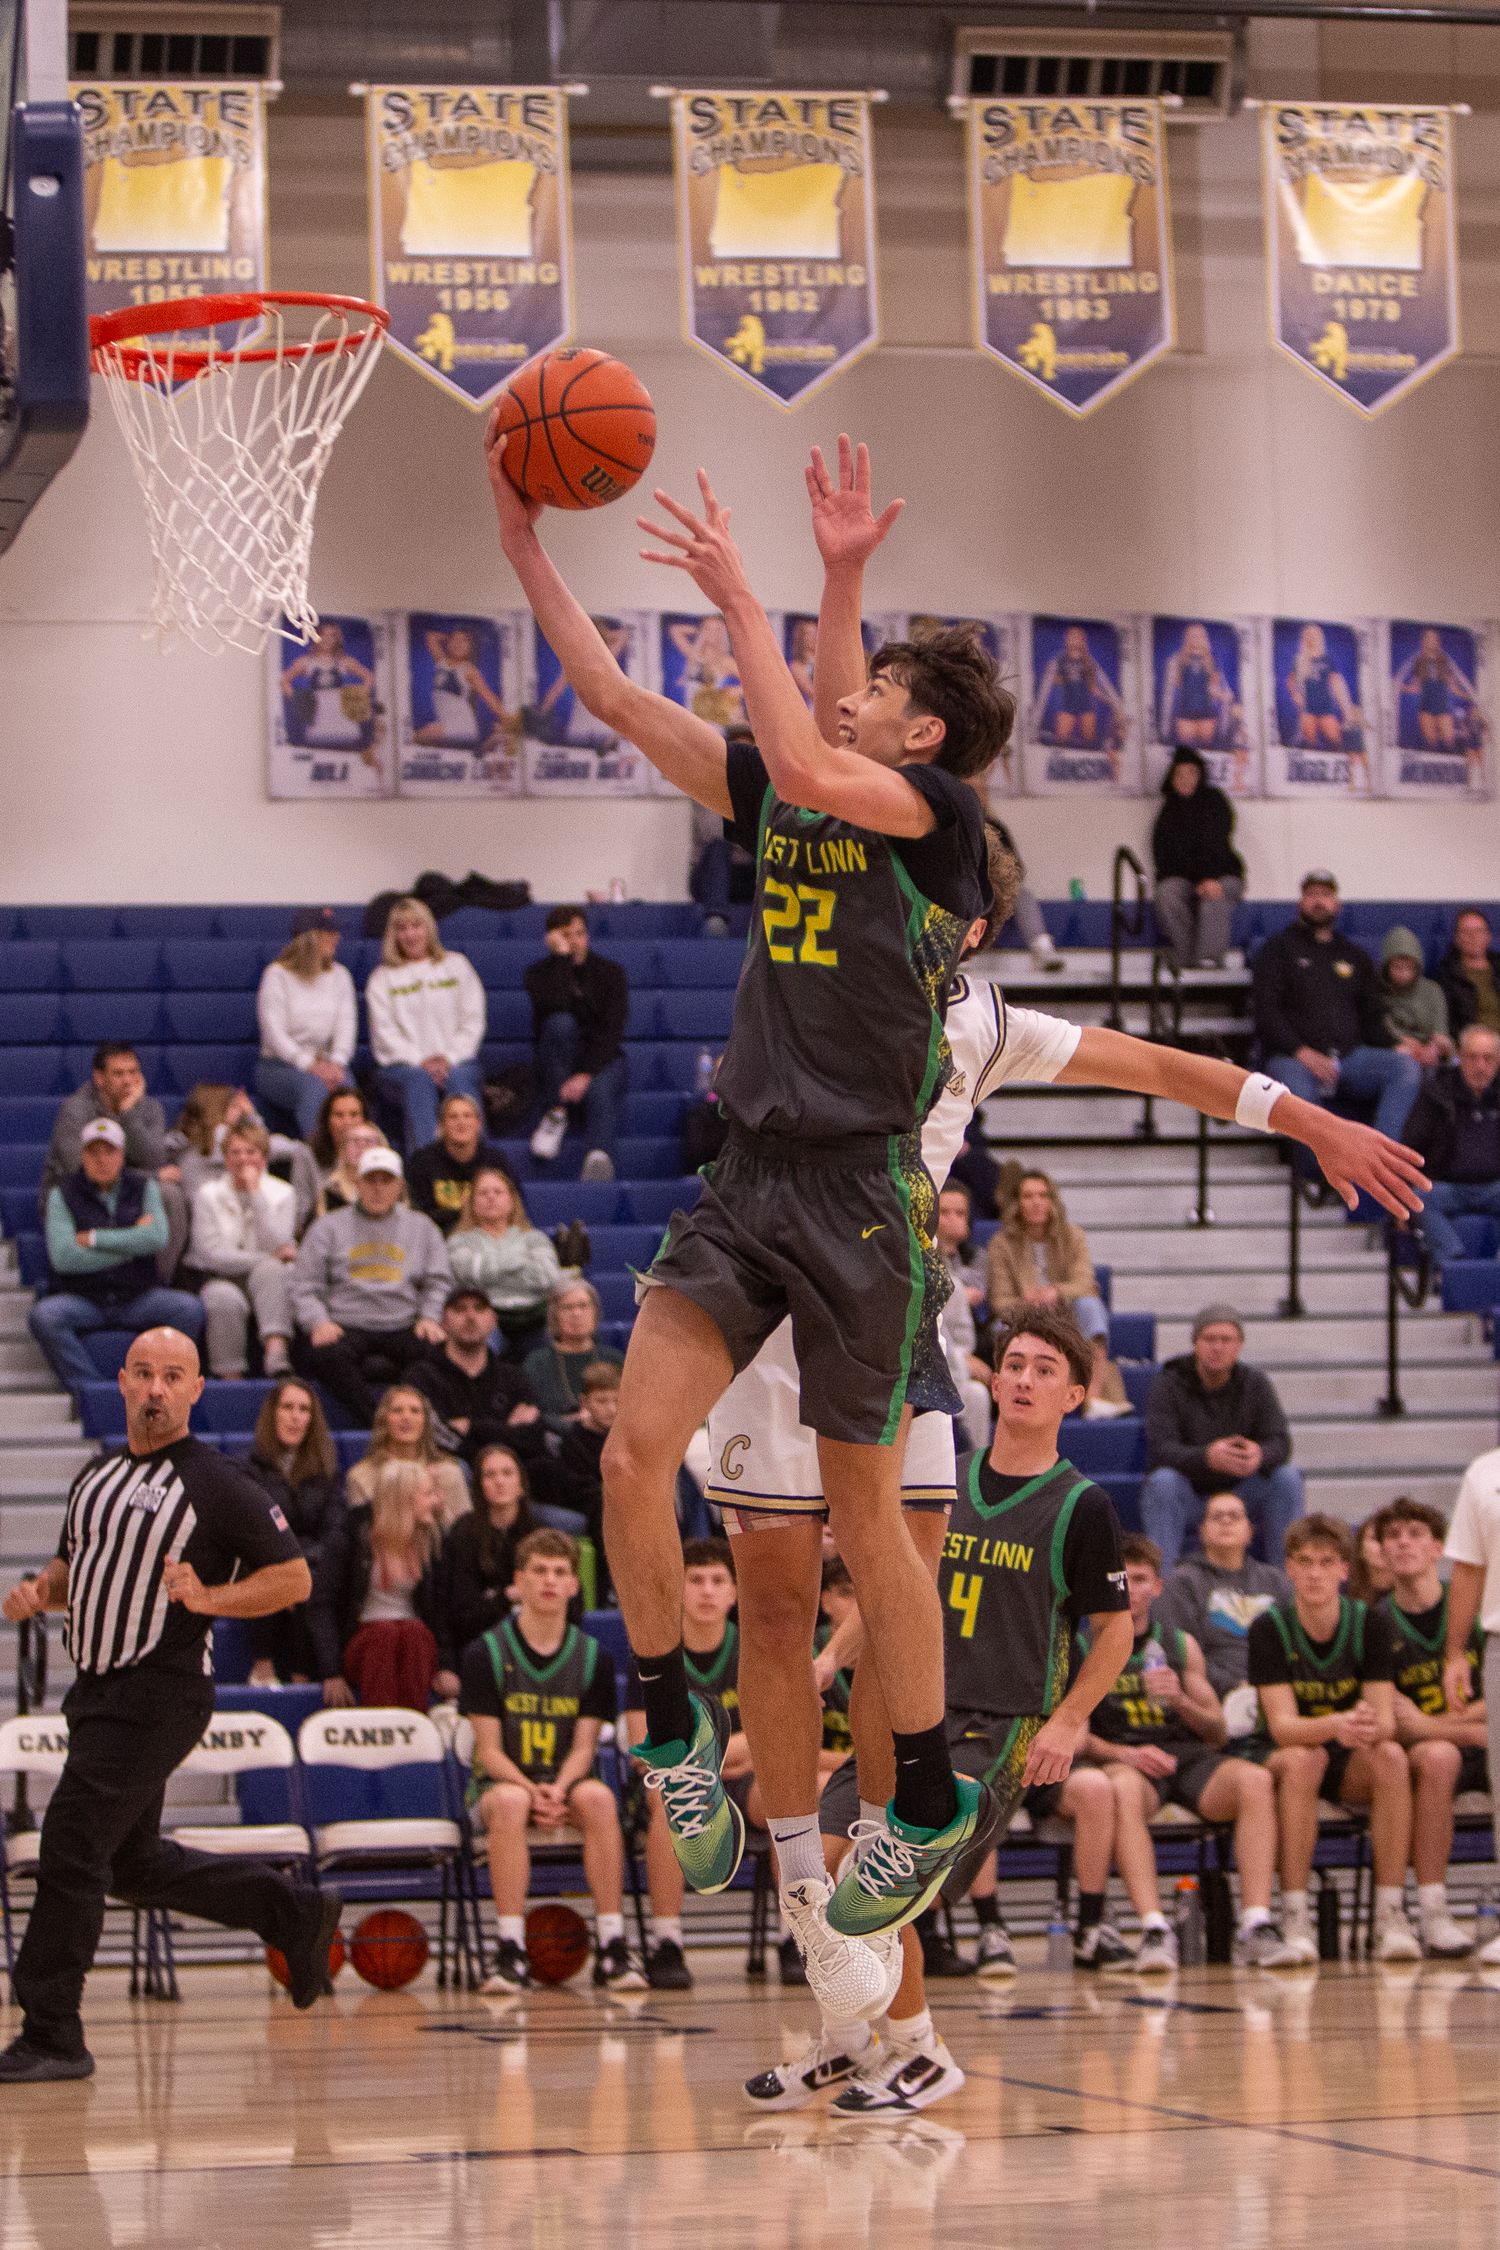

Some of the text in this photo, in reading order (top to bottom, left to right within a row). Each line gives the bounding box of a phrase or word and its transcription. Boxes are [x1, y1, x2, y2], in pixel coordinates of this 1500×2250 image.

[76, 89, 254, 131] STATE
[382, 91, 556, 134] STATE
[689, 96, 860, 138] STATE
[983, 104, 1153, 146] STATE
[1277, 108, 1444, 151] STATE
[384, 123, 558, 174] CHAMPIONS
[689, 129, 861, 178] CHAMPIONS
[982, 137, 1155, 186] CHAMPIONS
[386, 262, 560, 285] WRESTLING
[695, 264, 867, 288] WRESTLING
[989, 271, 1158, 295] WRESTLING
[1311, 272, 1419, 297] DANCE
[806, 838, 869, 874] LINN
[763, 875, 838, 967] 22
[721, 1434, 751, 1481] C
[979, 1537, 1034, 1573] LINN
[949, 1571, 983, 1639] 4
[18, 1734, 68, 1752] CAN
[200, 1728, 266, 1750] ANBY
[324, 1726, 417, 1747] CANBY
[520, 1719, 556, 1766] 14
